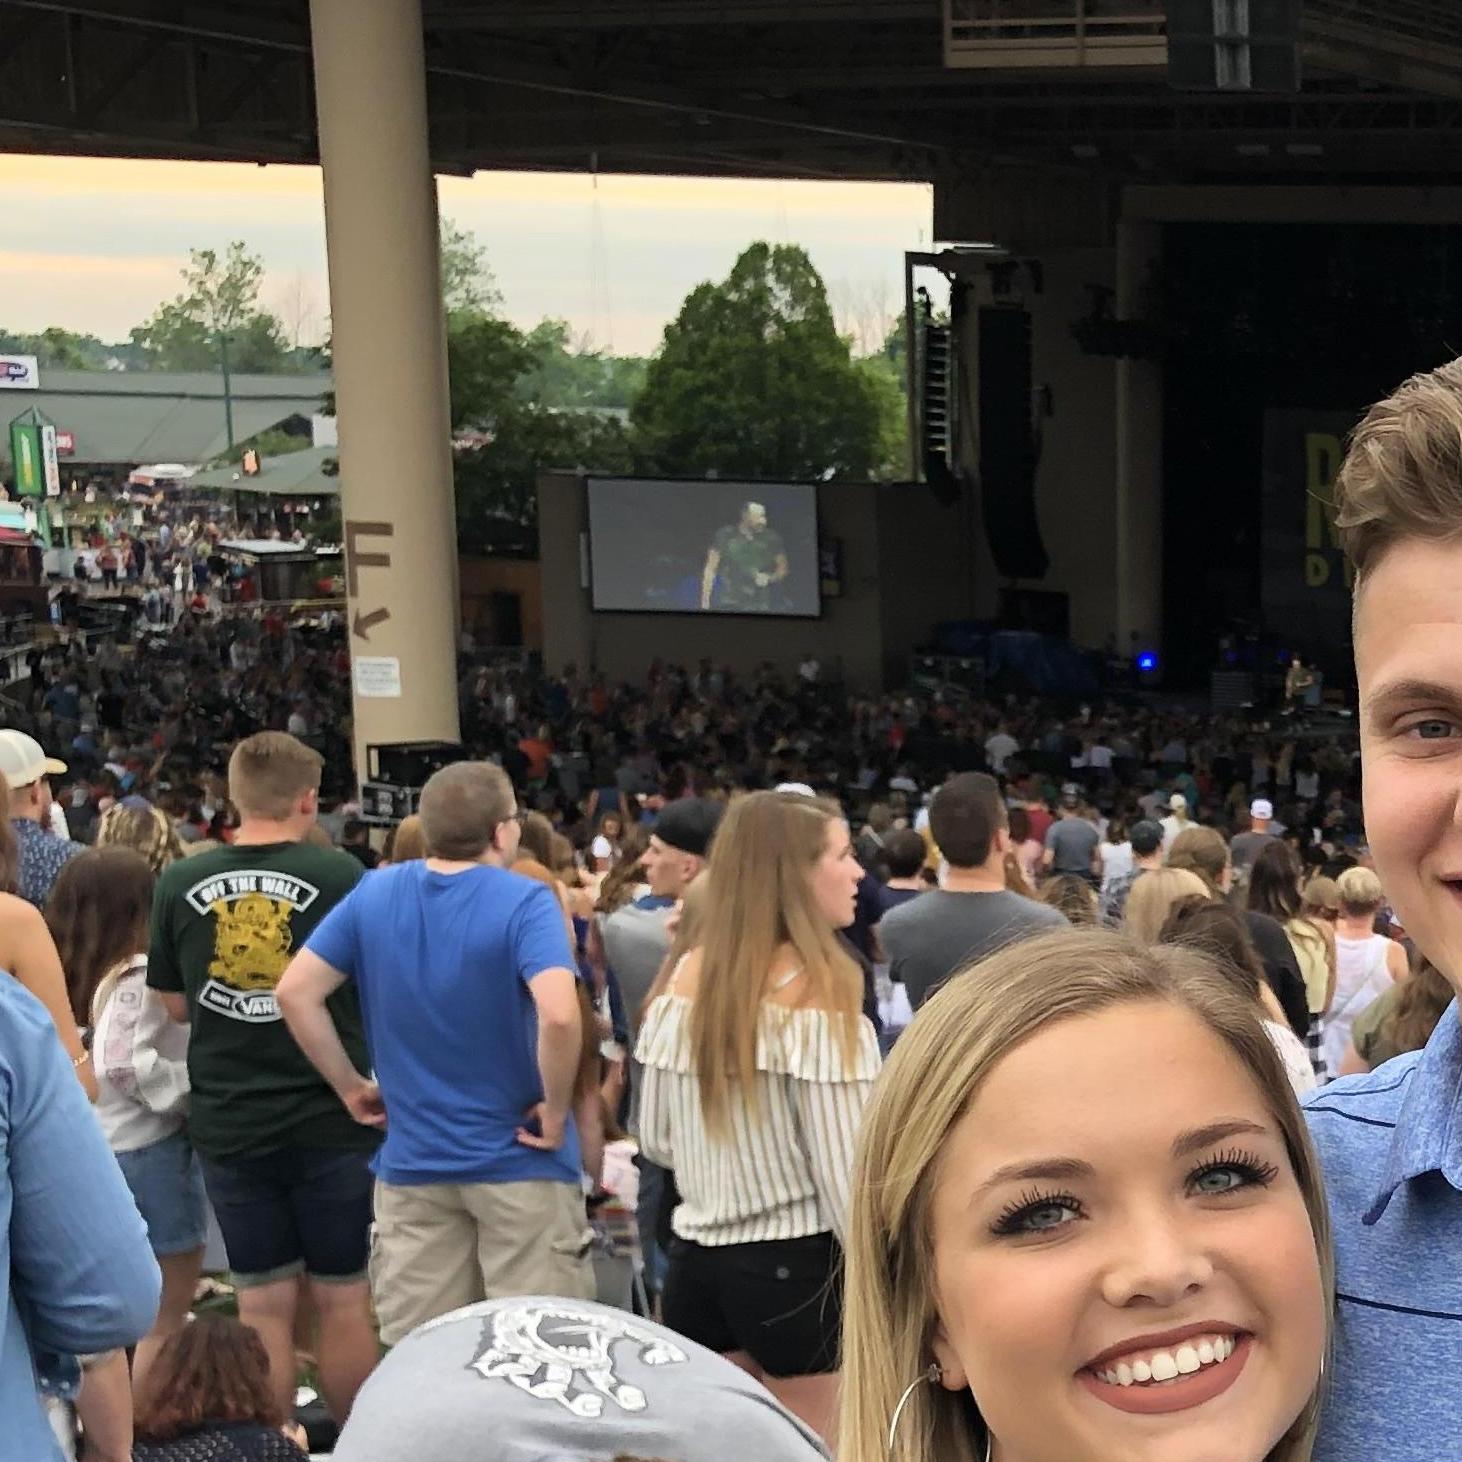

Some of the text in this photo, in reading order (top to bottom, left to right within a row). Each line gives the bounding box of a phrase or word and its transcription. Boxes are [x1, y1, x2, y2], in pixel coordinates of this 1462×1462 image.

[346, 522, 394, 599] F
[201, 876, 300, 903] OFF THE WALL
